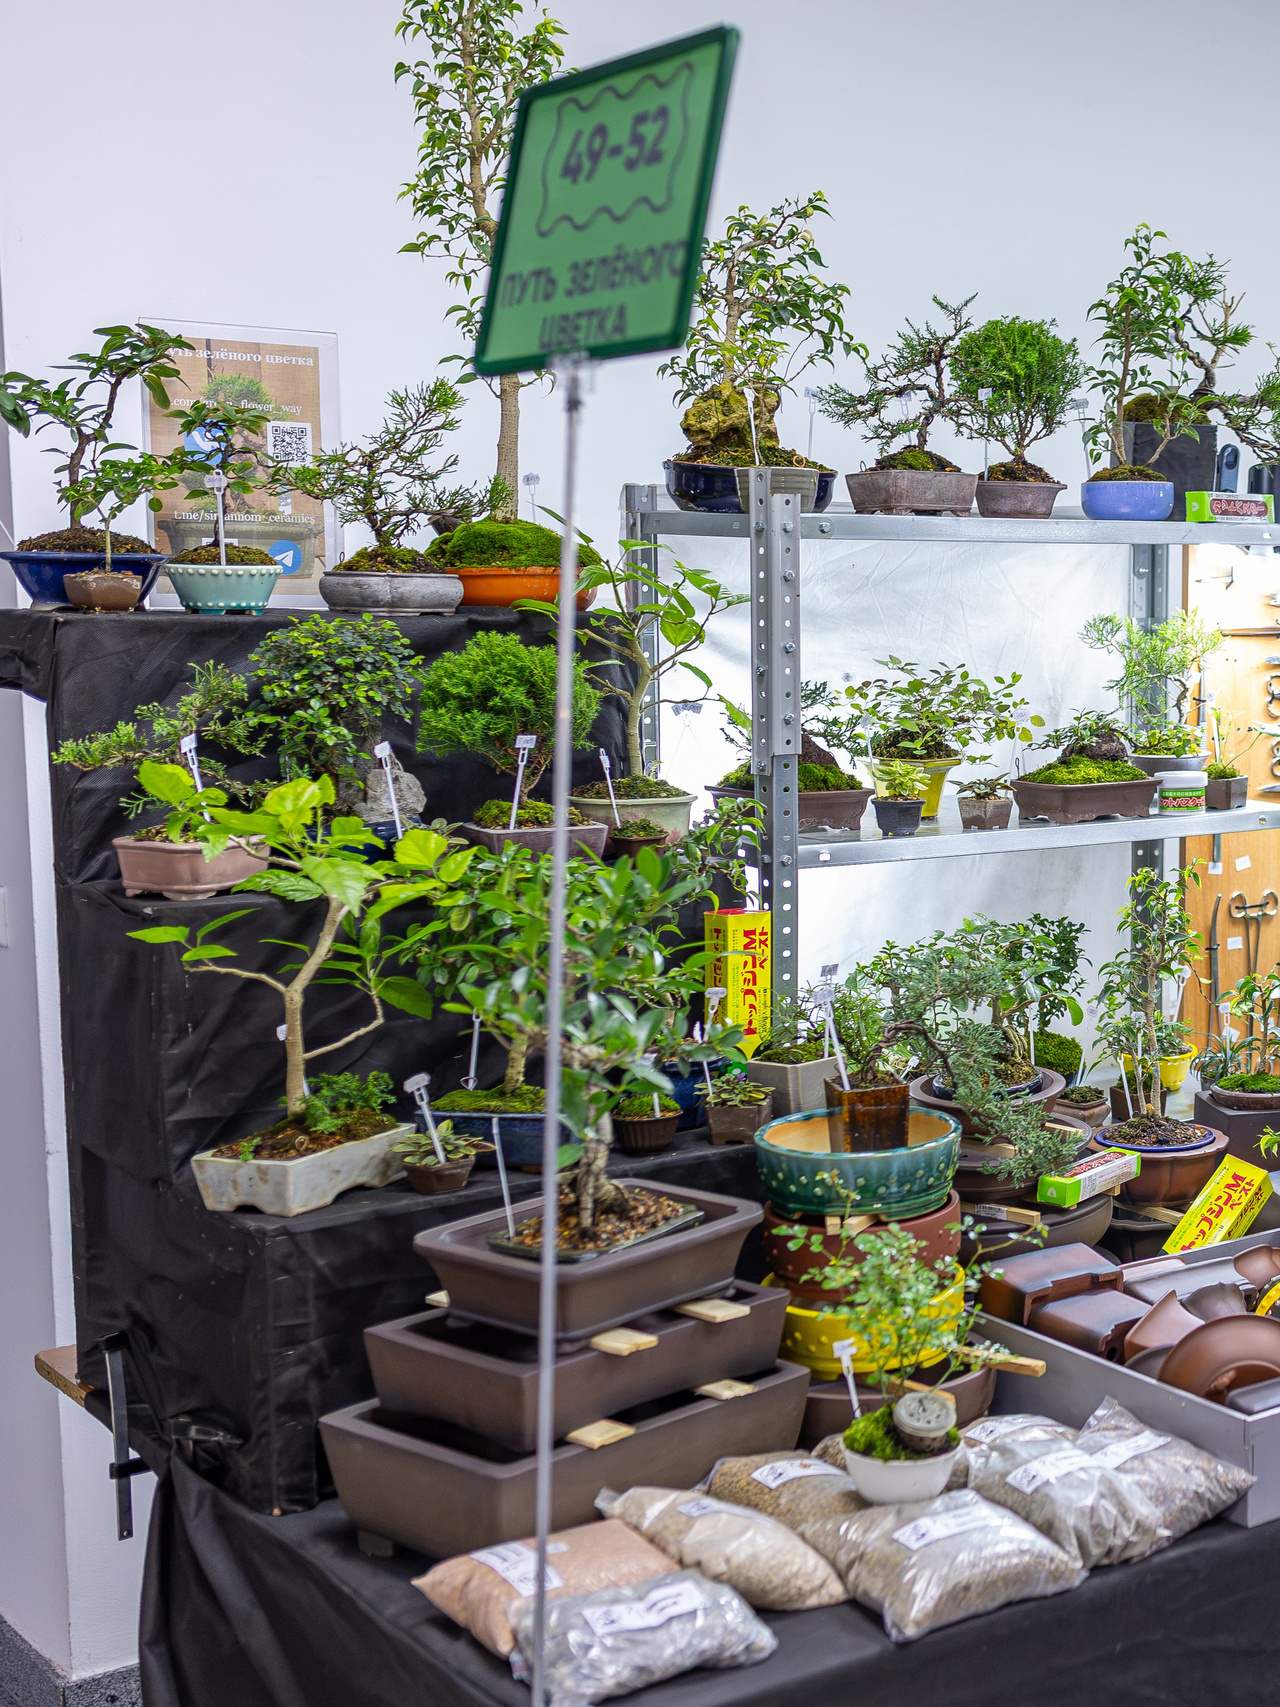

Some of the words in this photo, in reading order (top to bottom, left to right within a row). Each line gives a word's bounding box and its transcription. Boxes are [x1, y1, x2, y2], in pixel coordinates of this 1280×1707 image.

[560, 105, 671, 186] 49-52
[501, 267, 558, 309] ПУТЬ
[565, 238, 690, 298] ЗЕЛЁНОГО
[539, 304, 628, 351] ЦВЕТКА
[169, 347, 193, 358] уть
[196, 347, 262, 363] зелёного
[265, 353, 315, 367] цветка
[173, 510, 316, 524] t.me/sinannom_ceramics
[757, 926, 769, 970] ペースト
[741, 928, 757, 1036] トップジンM
[1180, 1172, 1247, 1251] トップジンM
[1229, 1178, 1255, 1211] ペースト
